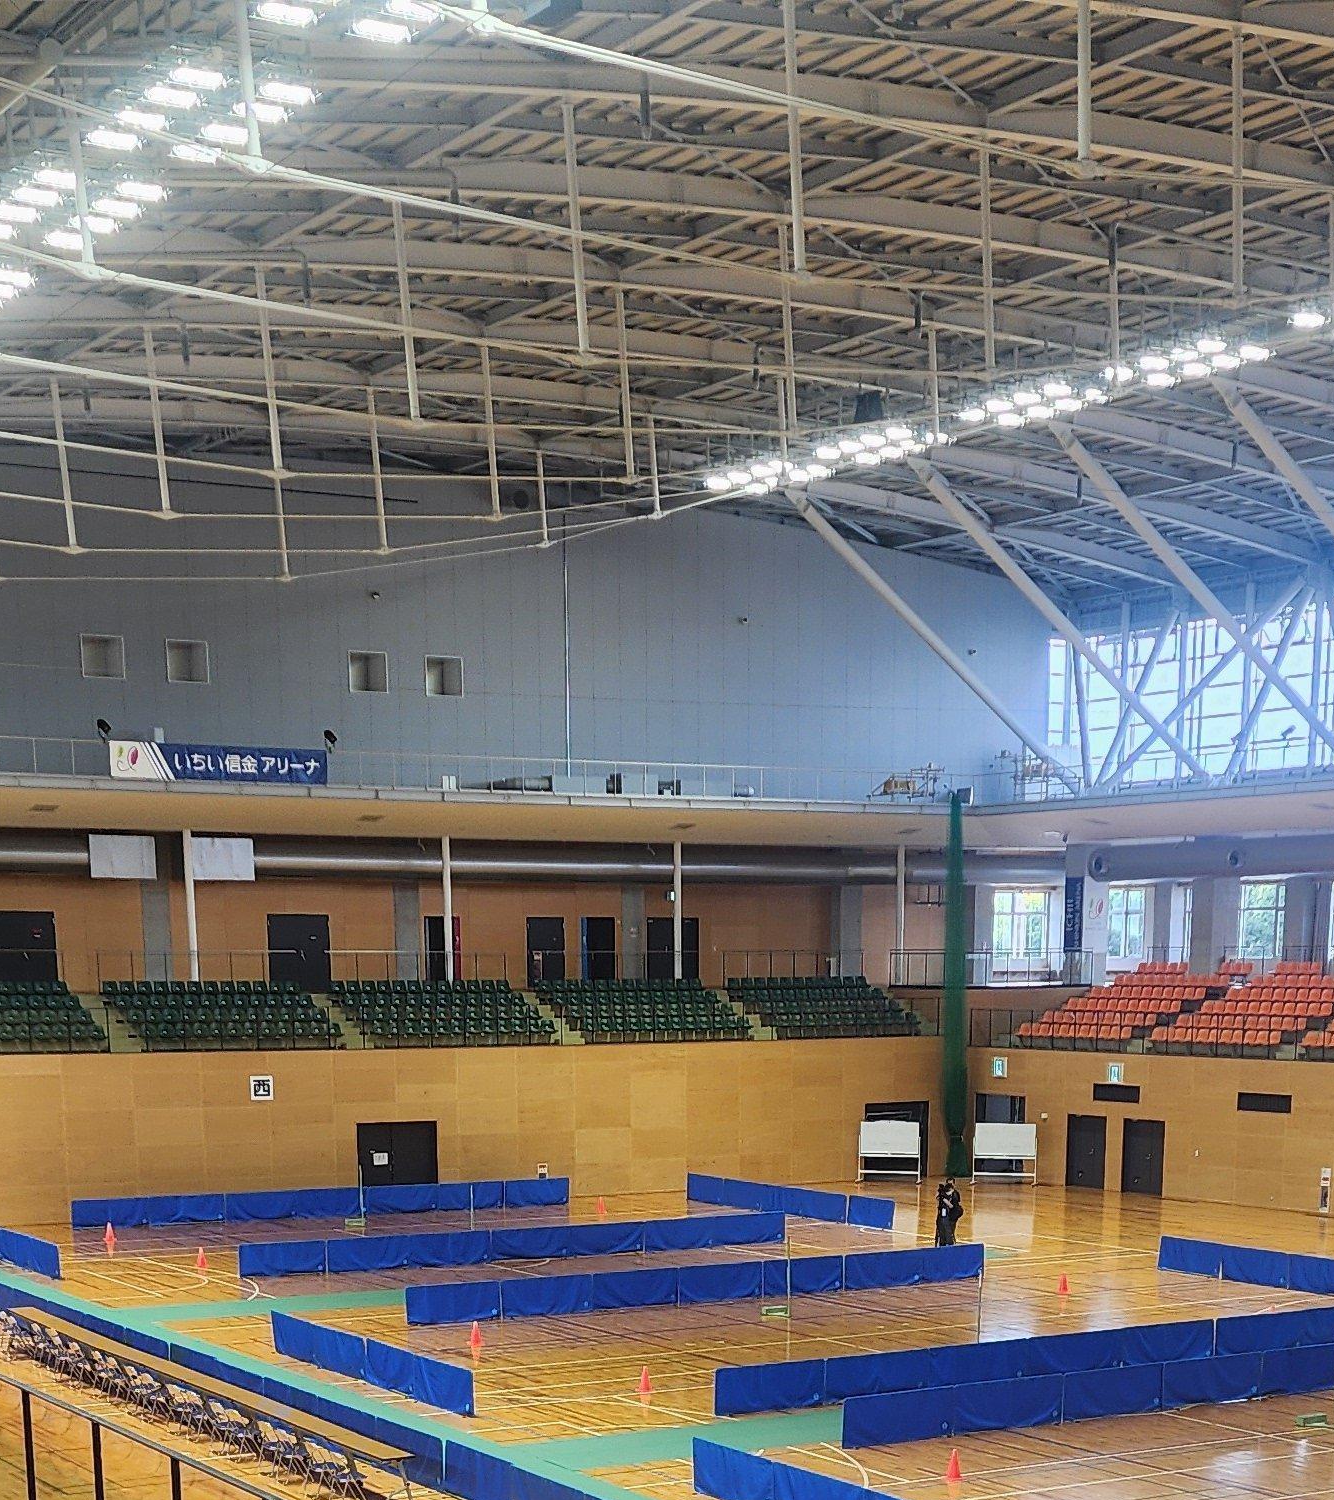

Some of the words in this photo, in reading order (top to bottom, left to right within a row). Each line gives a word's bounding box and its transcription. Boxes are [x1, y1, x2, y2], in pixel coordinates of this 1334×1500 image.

[174, 752, 321, 776] いちい信金アリーナ
[252, 1079, 271, 1097] 西
